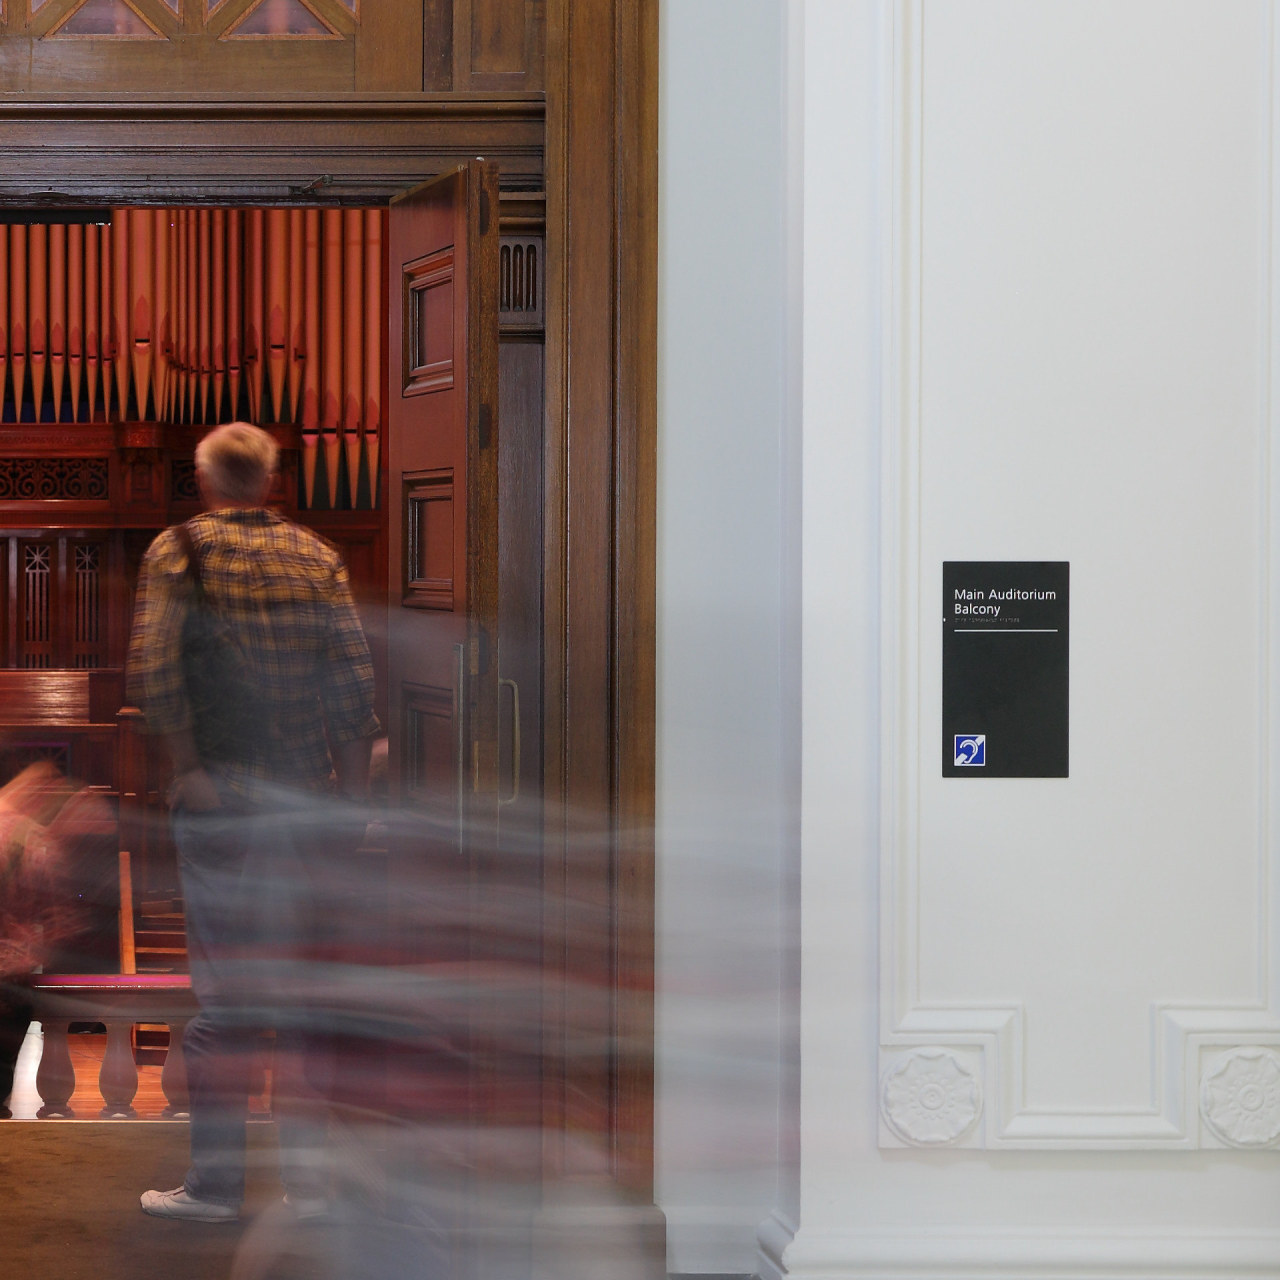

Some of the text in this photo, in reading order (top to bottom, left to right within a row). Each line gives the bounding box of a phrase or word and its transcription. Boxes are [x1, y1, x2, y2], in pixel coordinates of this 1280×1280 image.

[954, 588, 1057, 601] Main Auditorium
[954, 602, 1001, 618] Balcony
